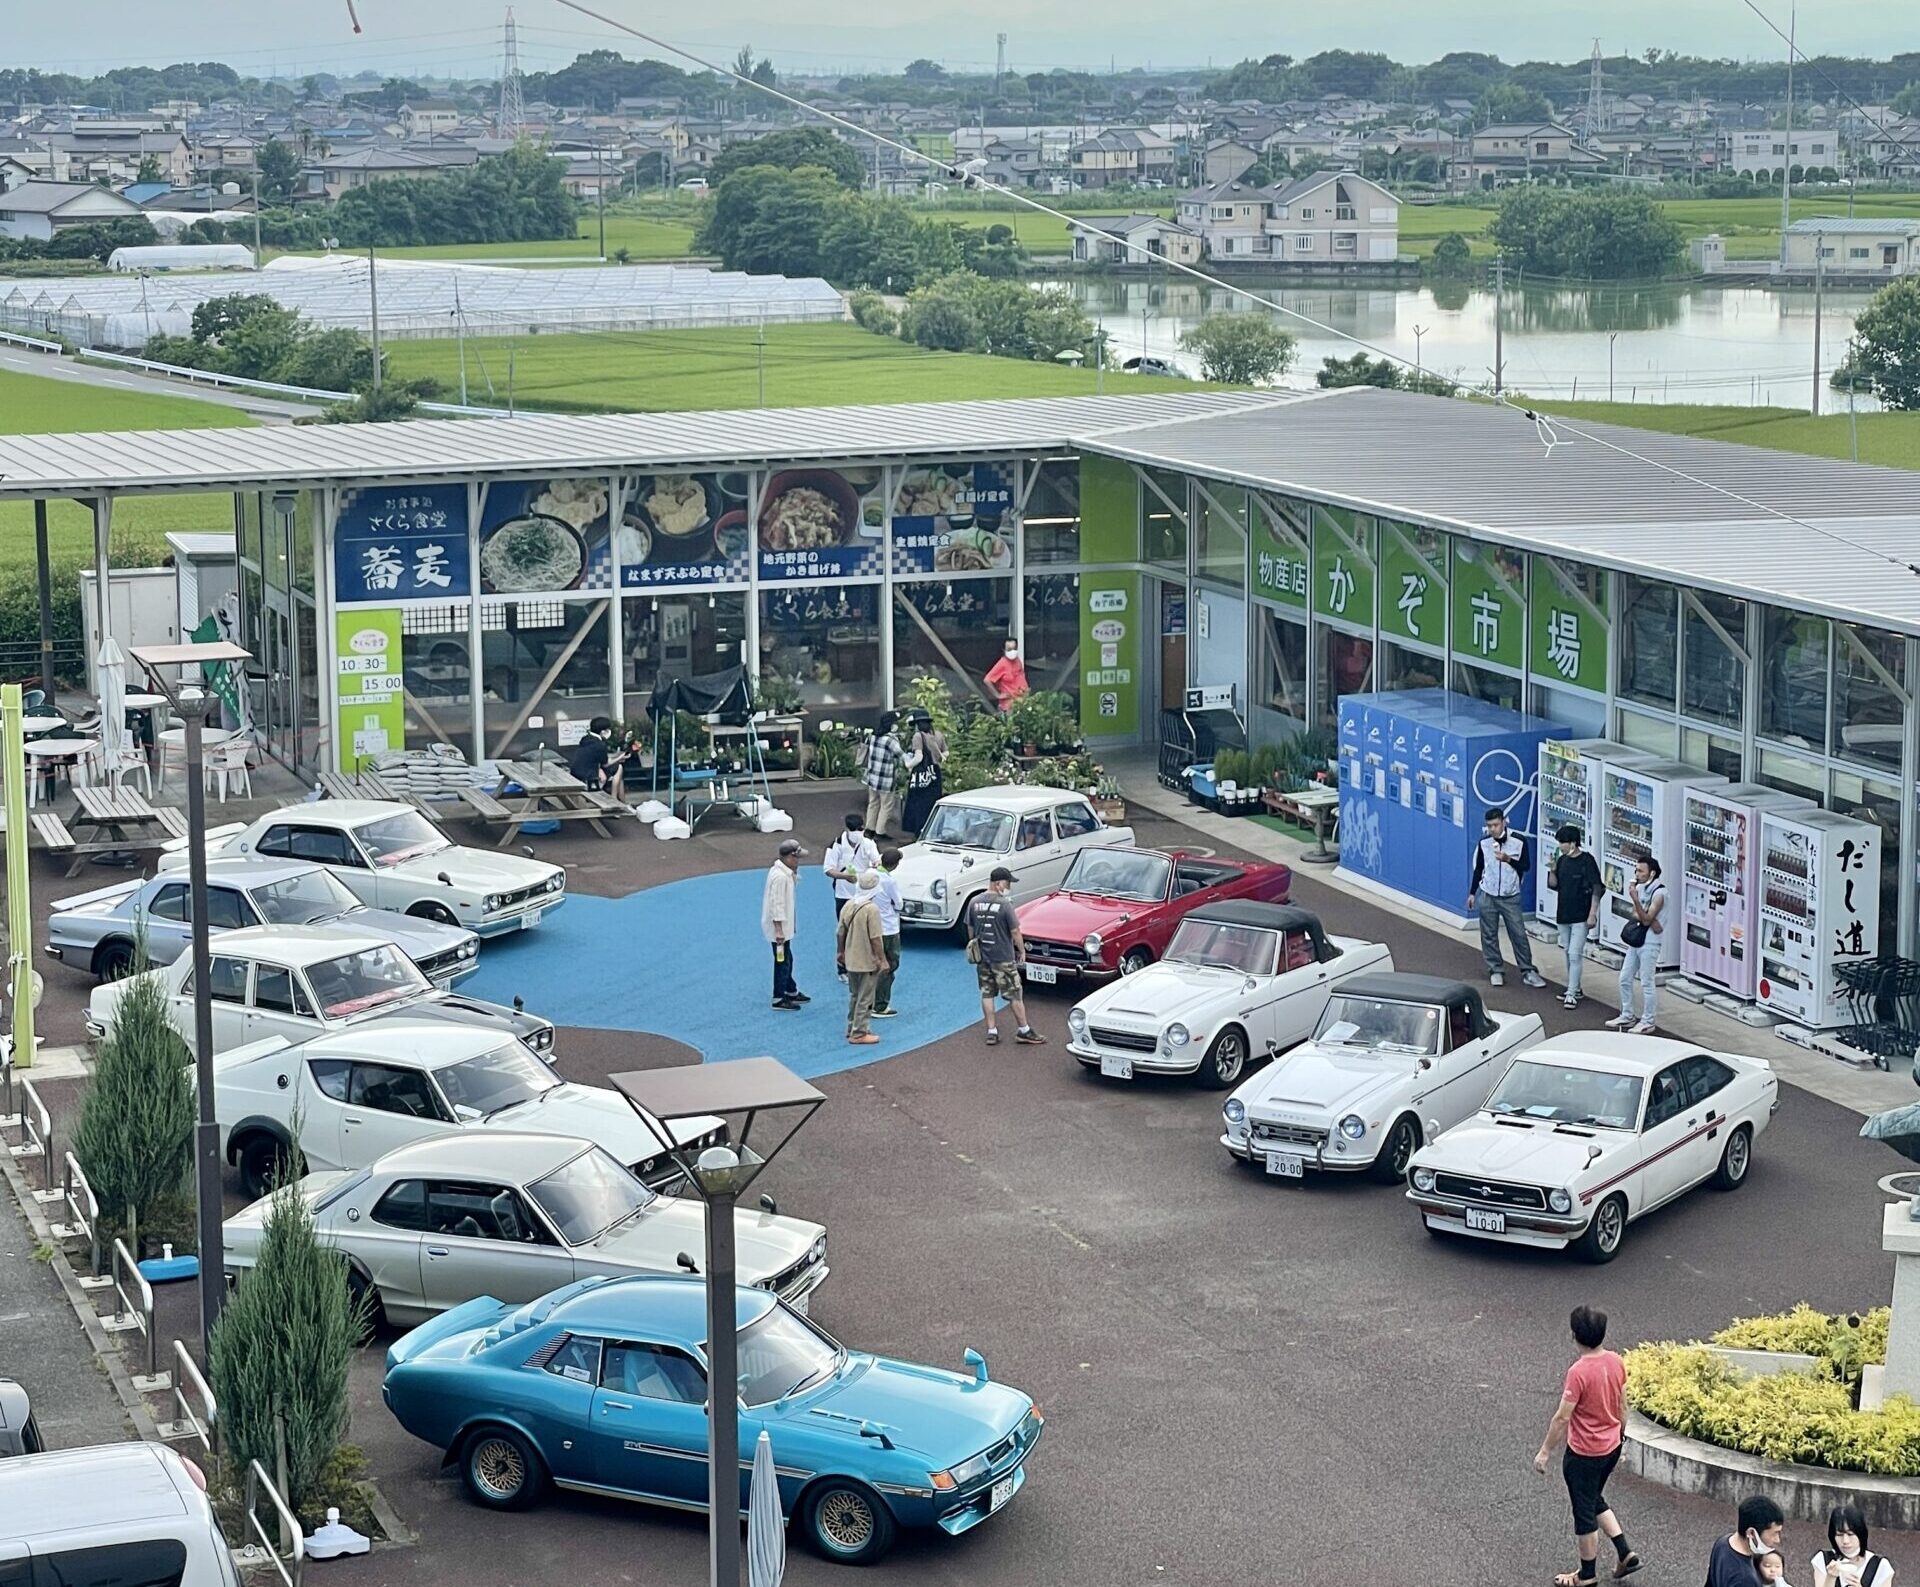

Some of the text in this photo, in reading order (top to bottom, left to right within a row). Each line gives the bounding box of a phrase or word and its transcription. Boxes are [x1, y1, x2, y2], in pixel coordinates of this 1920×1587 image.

[368, 511, 447, 532] さくら食堂
[361, 543, 452, 591] 蕎麦
[627, 564, 725, 582] なまず天ぷら定食
[1258, 551, 1307, 596] 物産店
[364, 677, 401, 690] 15:00
[1274, 1161, 1302, 1175] 20-00
[1475, 1217, 1503, 1232] 10-01
